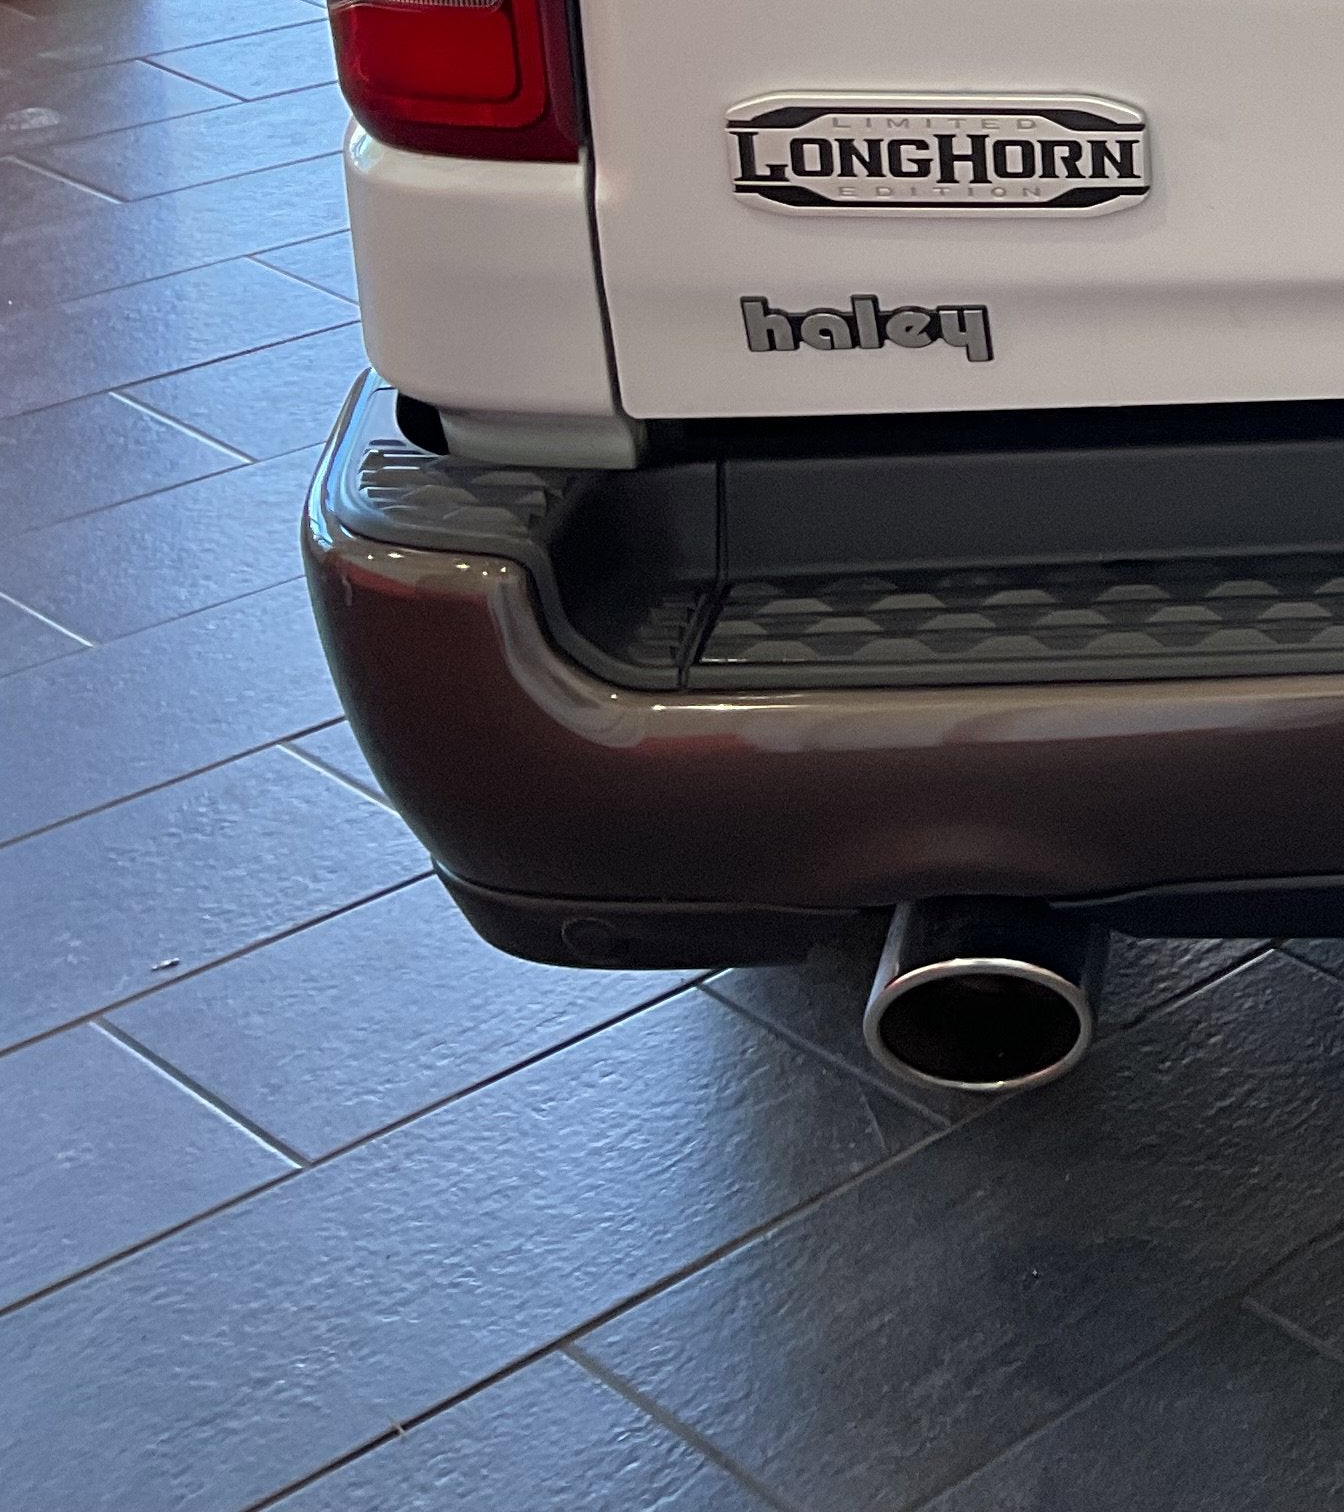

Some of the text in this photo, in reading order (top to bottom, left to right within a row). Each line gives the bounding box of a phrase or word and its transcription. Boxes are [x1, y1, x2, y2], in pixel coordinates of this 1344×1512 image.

[831, 117, 1038, 130] LIMITED
[838, 186, 1043, 198] EDITION
[739, 294, 995, 363] haley
